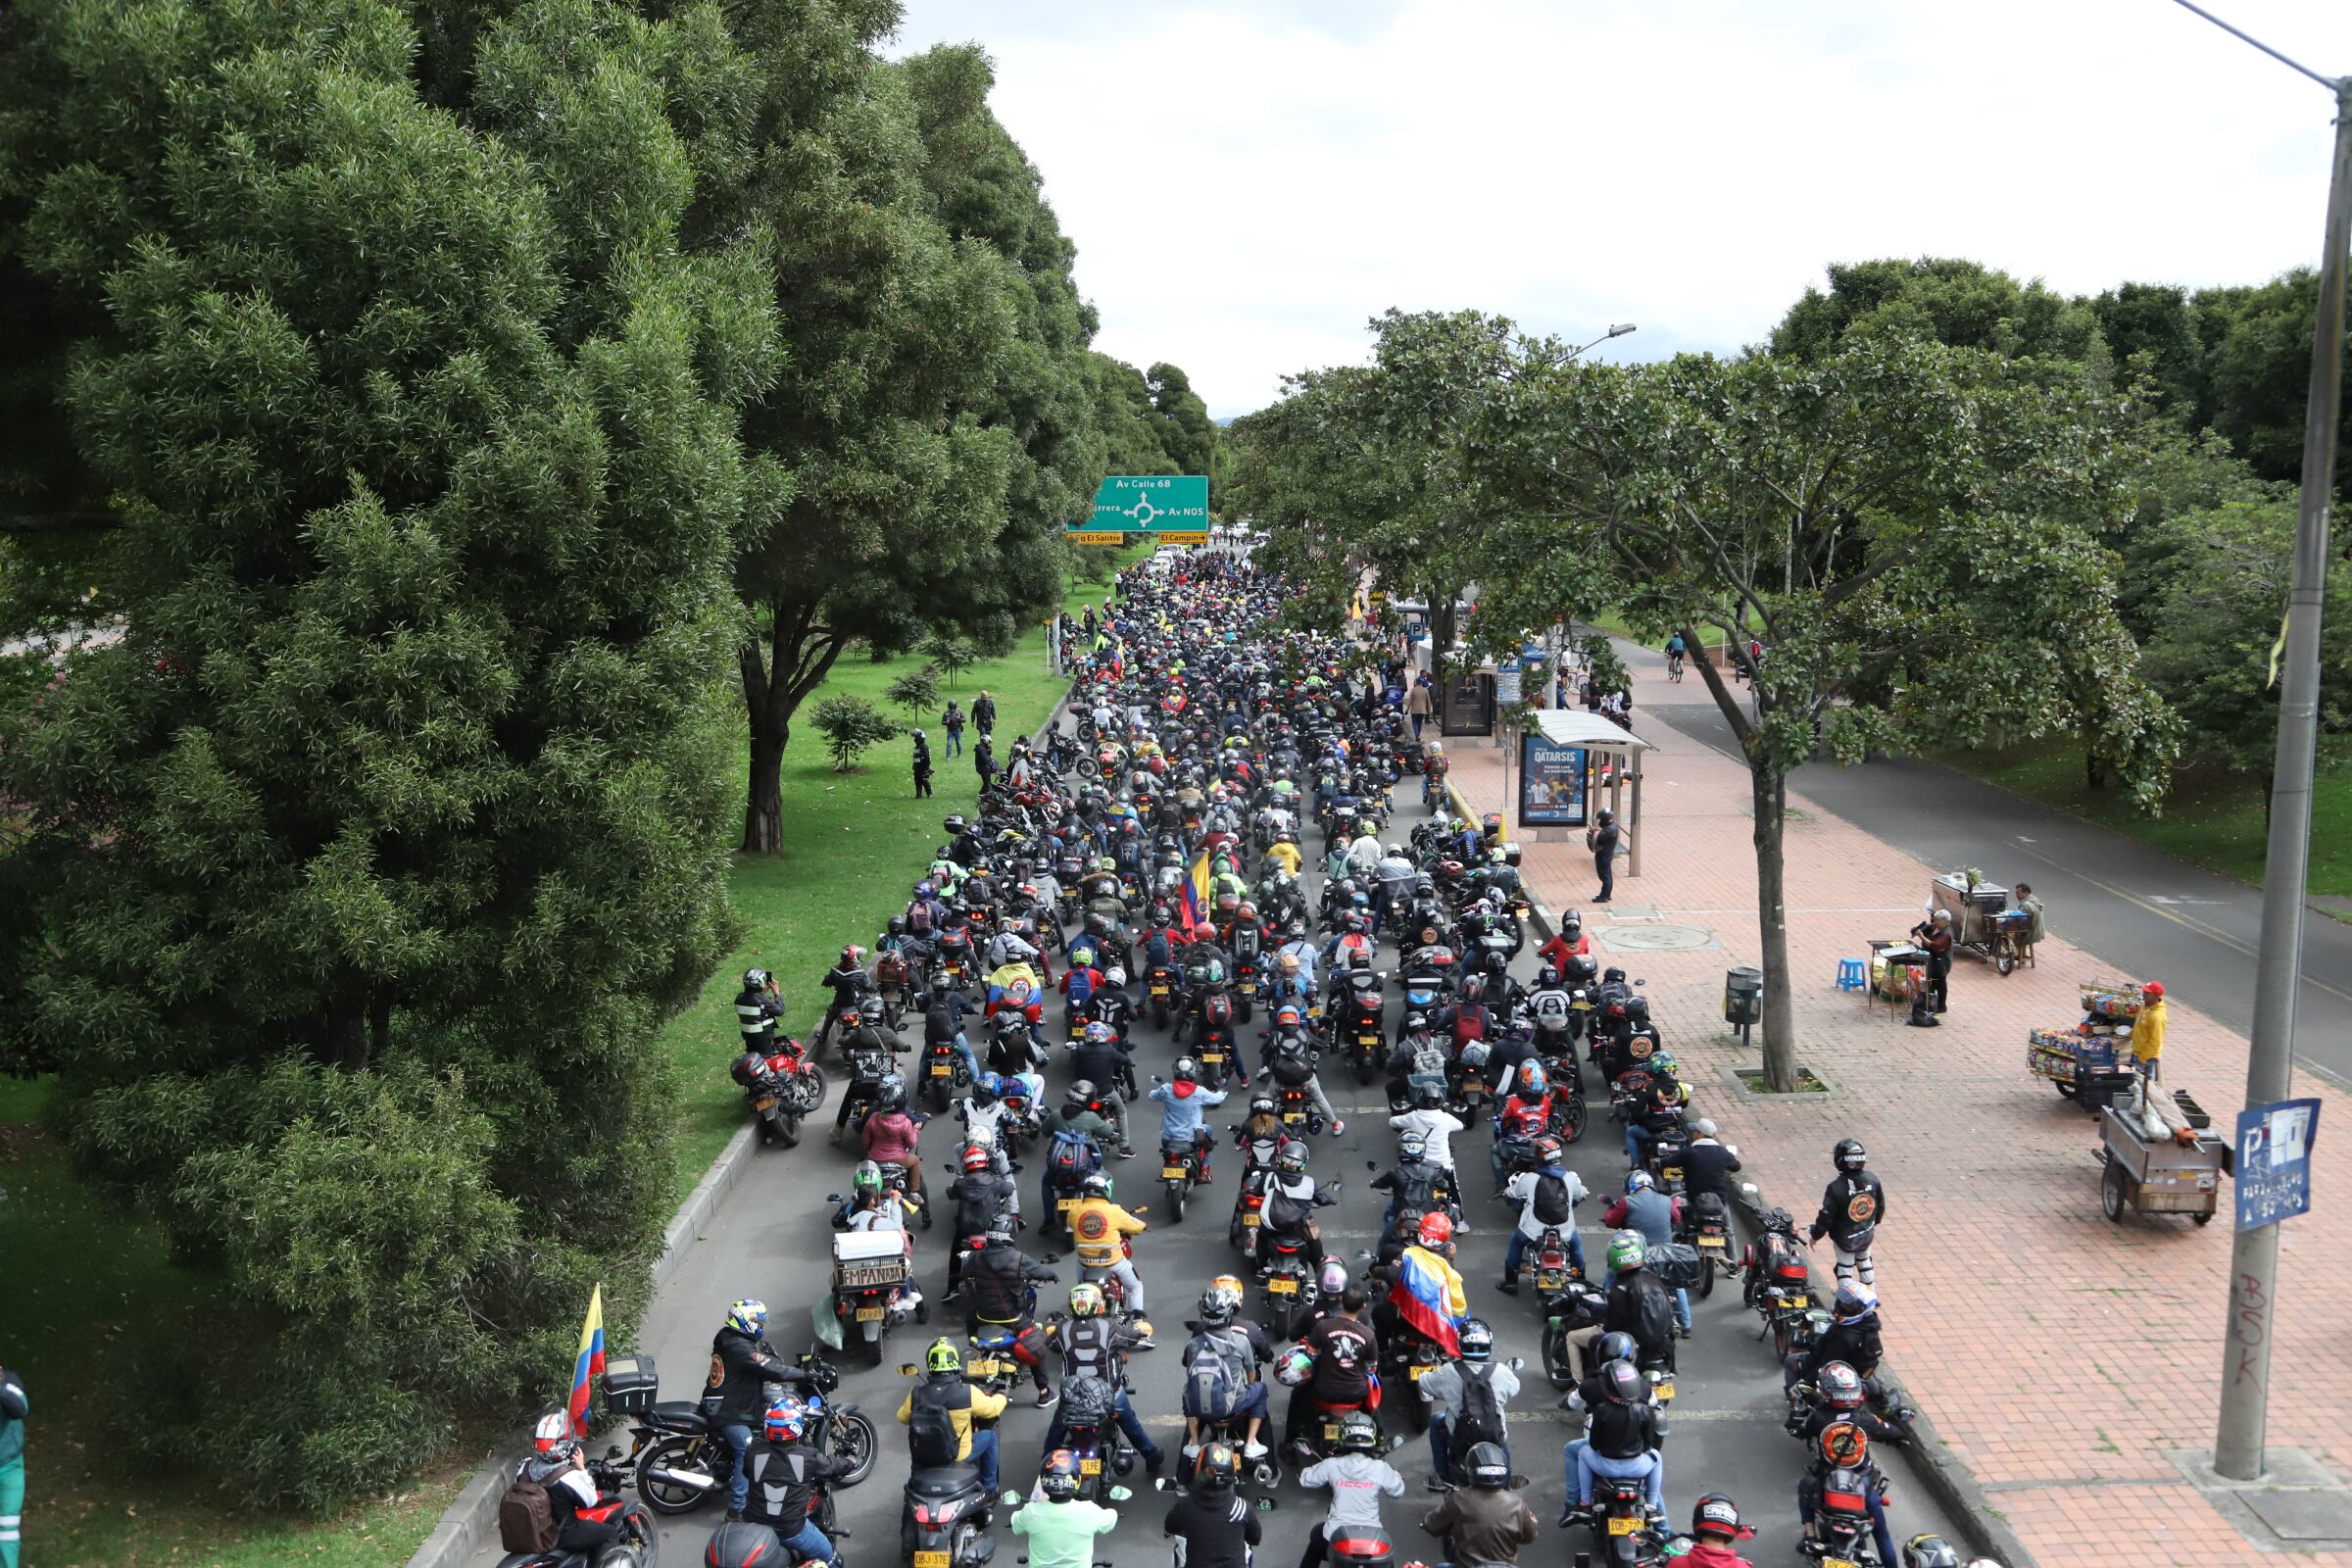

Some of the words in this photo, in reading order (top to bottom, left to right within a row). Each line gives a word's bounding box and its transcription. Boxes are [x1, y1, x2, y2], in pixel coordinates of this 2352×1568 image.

[1116, 479, 1129, 488] Av
[1132, 479, 1154, 488] Calle
[1157, 479, 1171, 488] 68
[1413, 625, 1421, 635] P
[1535, 752, 1576, 762] QATARSIS
[2243, 1127, 2263, 1168] P
